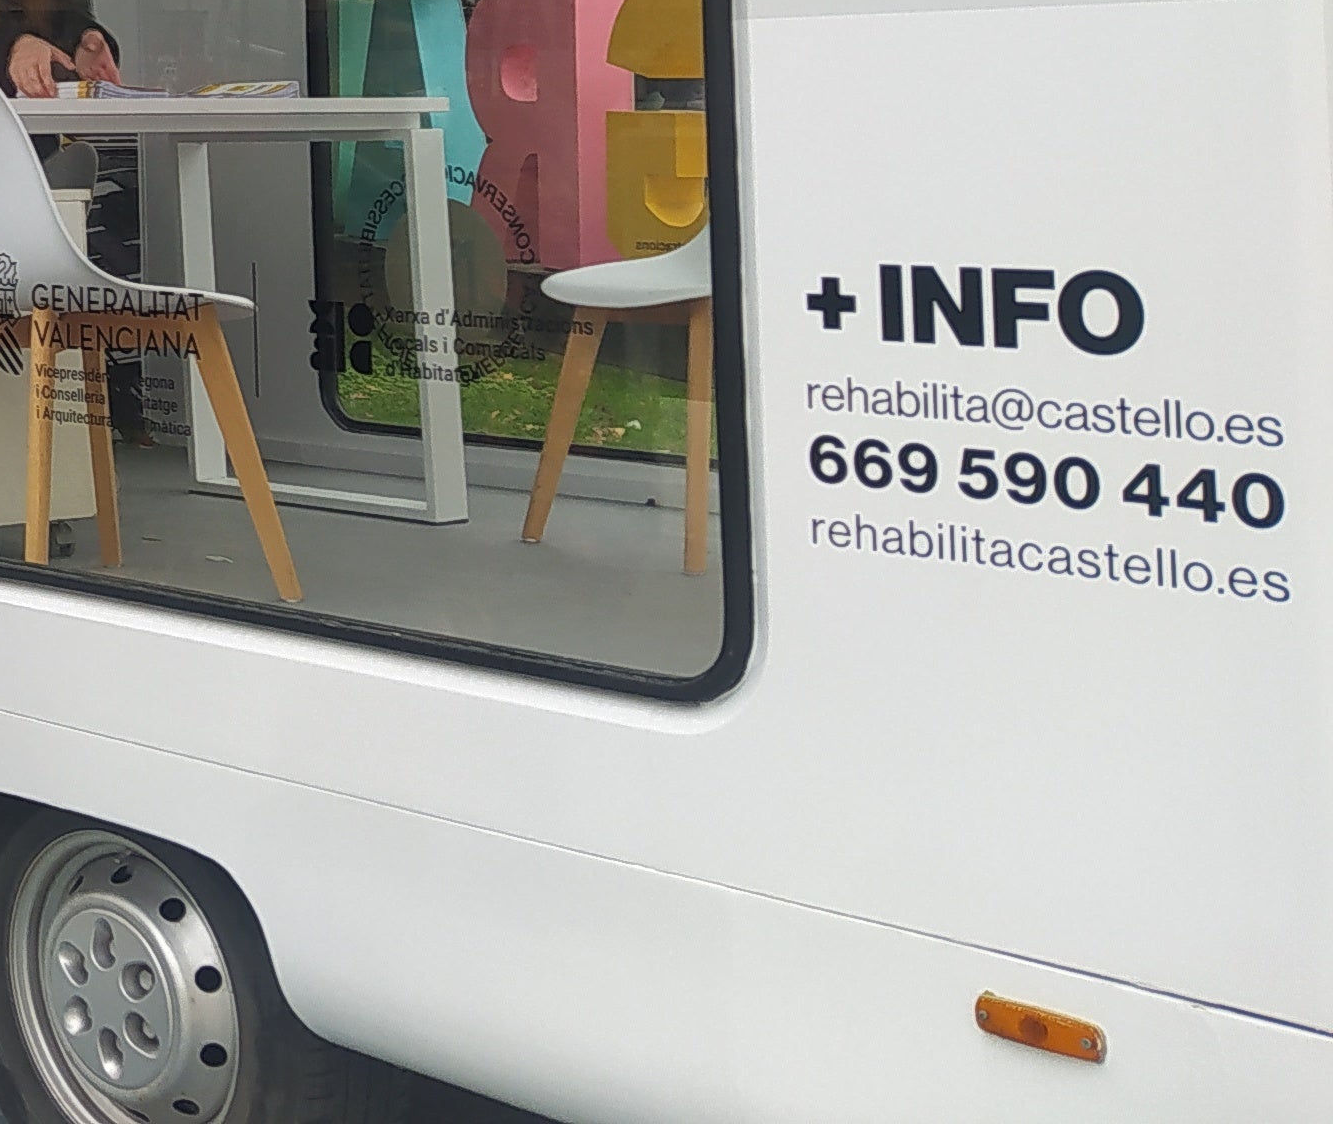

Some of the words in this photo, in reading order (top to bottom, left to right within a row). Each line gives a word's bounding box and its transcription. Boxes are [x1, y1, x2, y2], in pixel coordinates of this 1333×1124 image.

[32, 283, 206, 322] GENERALITAT
[34, 320, 203, 361] VALENCIANA
[879, 263, 1145, 356] INFO
[807, 377, 1284, 447] rehabilita@castello.es
[809, 434, 938, 494] 669
[958, 447, 1101, 510] 590
[1122, 463, 1285, 529] 440
[811, 513, 1290, 603] rehabilitacastello.es
